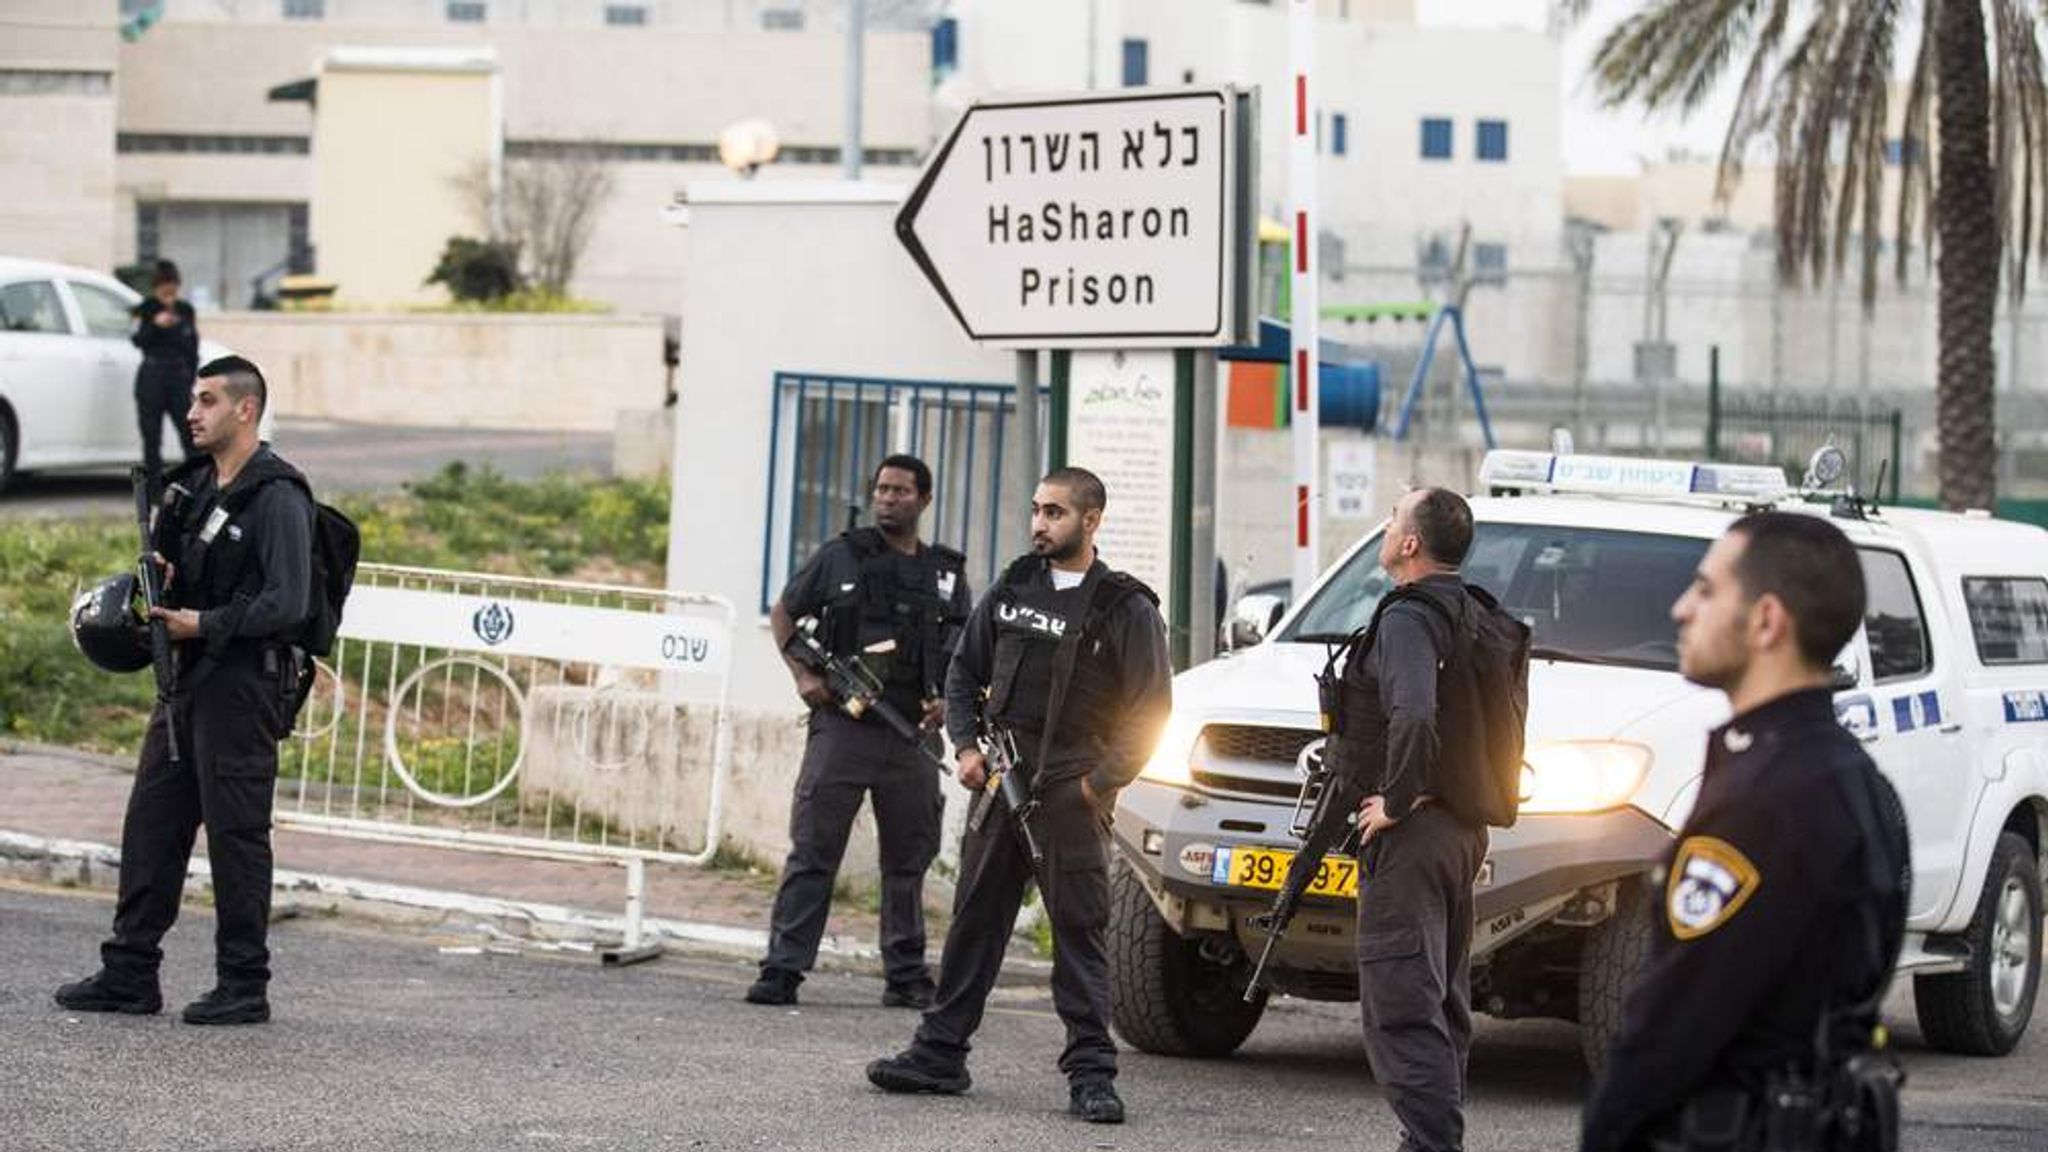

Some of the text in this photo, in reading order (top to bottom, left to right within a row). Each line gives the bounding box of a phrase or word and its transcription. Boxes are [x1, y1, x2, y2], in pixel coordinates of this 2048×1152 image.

[982, 121, 1199, 182] כלא השרון
[988, 203, 1189, 244] HaSharon
[1021, 267, 1154, 307] Prison
[661, 634, 708, 662] שבס
